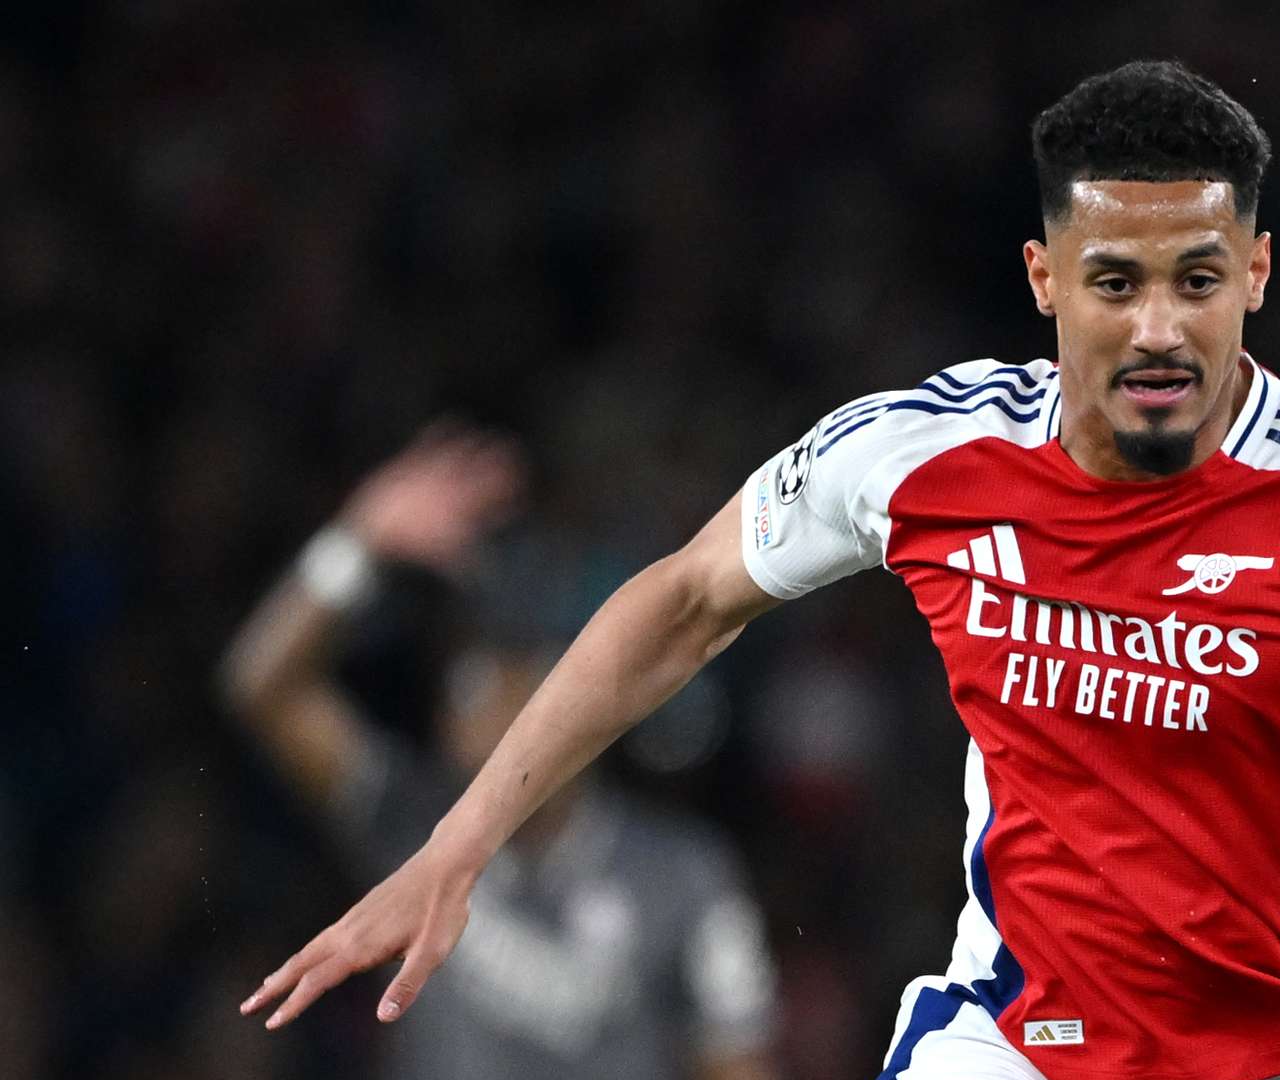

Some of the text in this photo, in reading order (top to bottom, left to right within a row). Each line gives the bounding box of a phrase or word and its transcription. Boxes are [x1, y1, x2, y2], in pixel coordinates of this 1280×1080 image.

[966, 577, 1260, 677] Emirates
[1000, 653, 1210, 732] FLY BETTER
